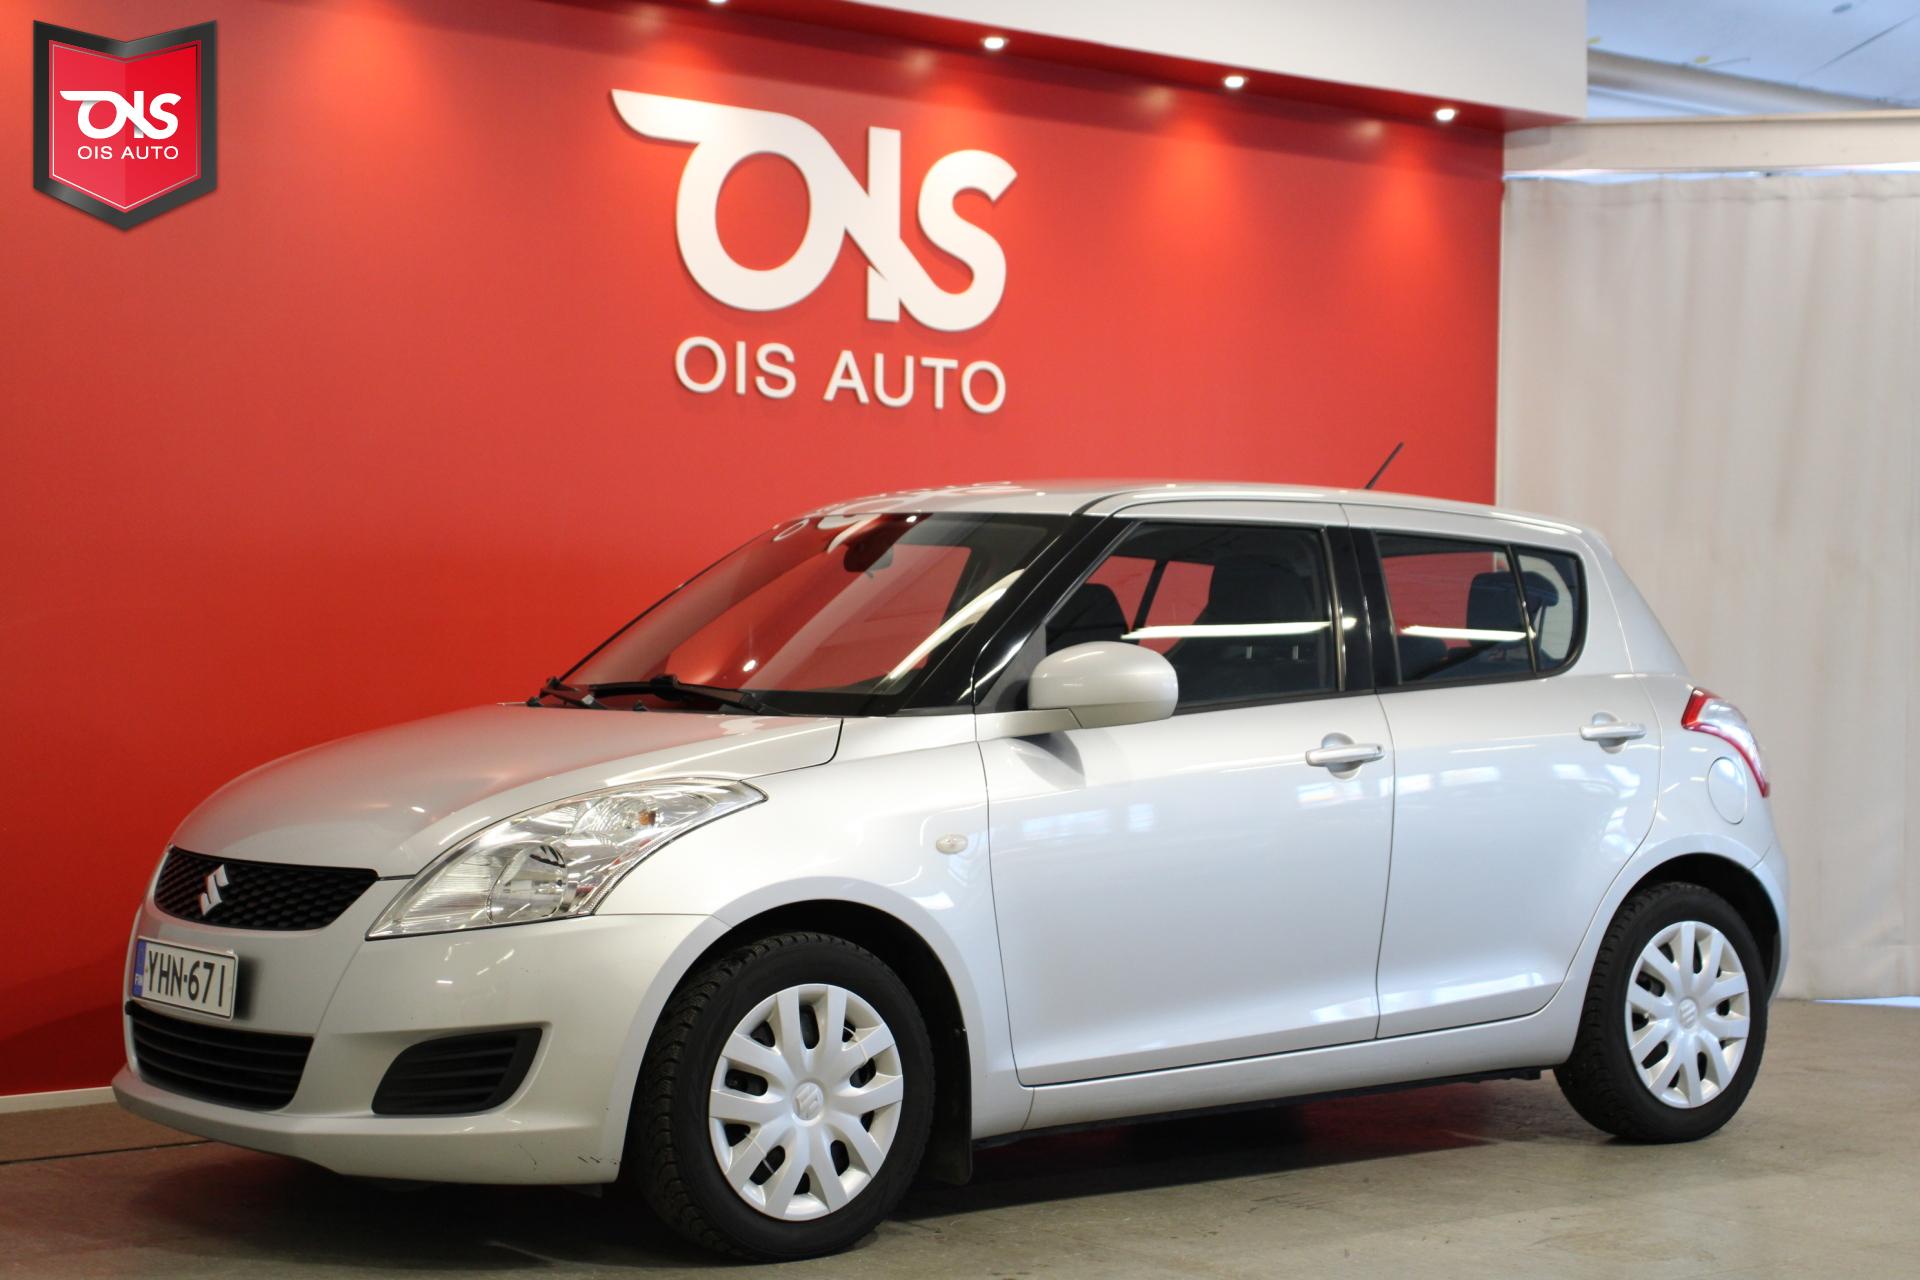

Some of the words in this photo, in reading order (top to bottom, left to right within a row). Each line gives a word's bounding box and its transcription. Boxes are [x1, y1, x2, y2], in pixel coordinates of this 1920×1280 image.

[611, 88, 1017, 331] OIS
[675, 336, 797, 398] OIS
[822, 350, 1006, 414] AUTO
[148, 950, 226, 1007] YHN-671
